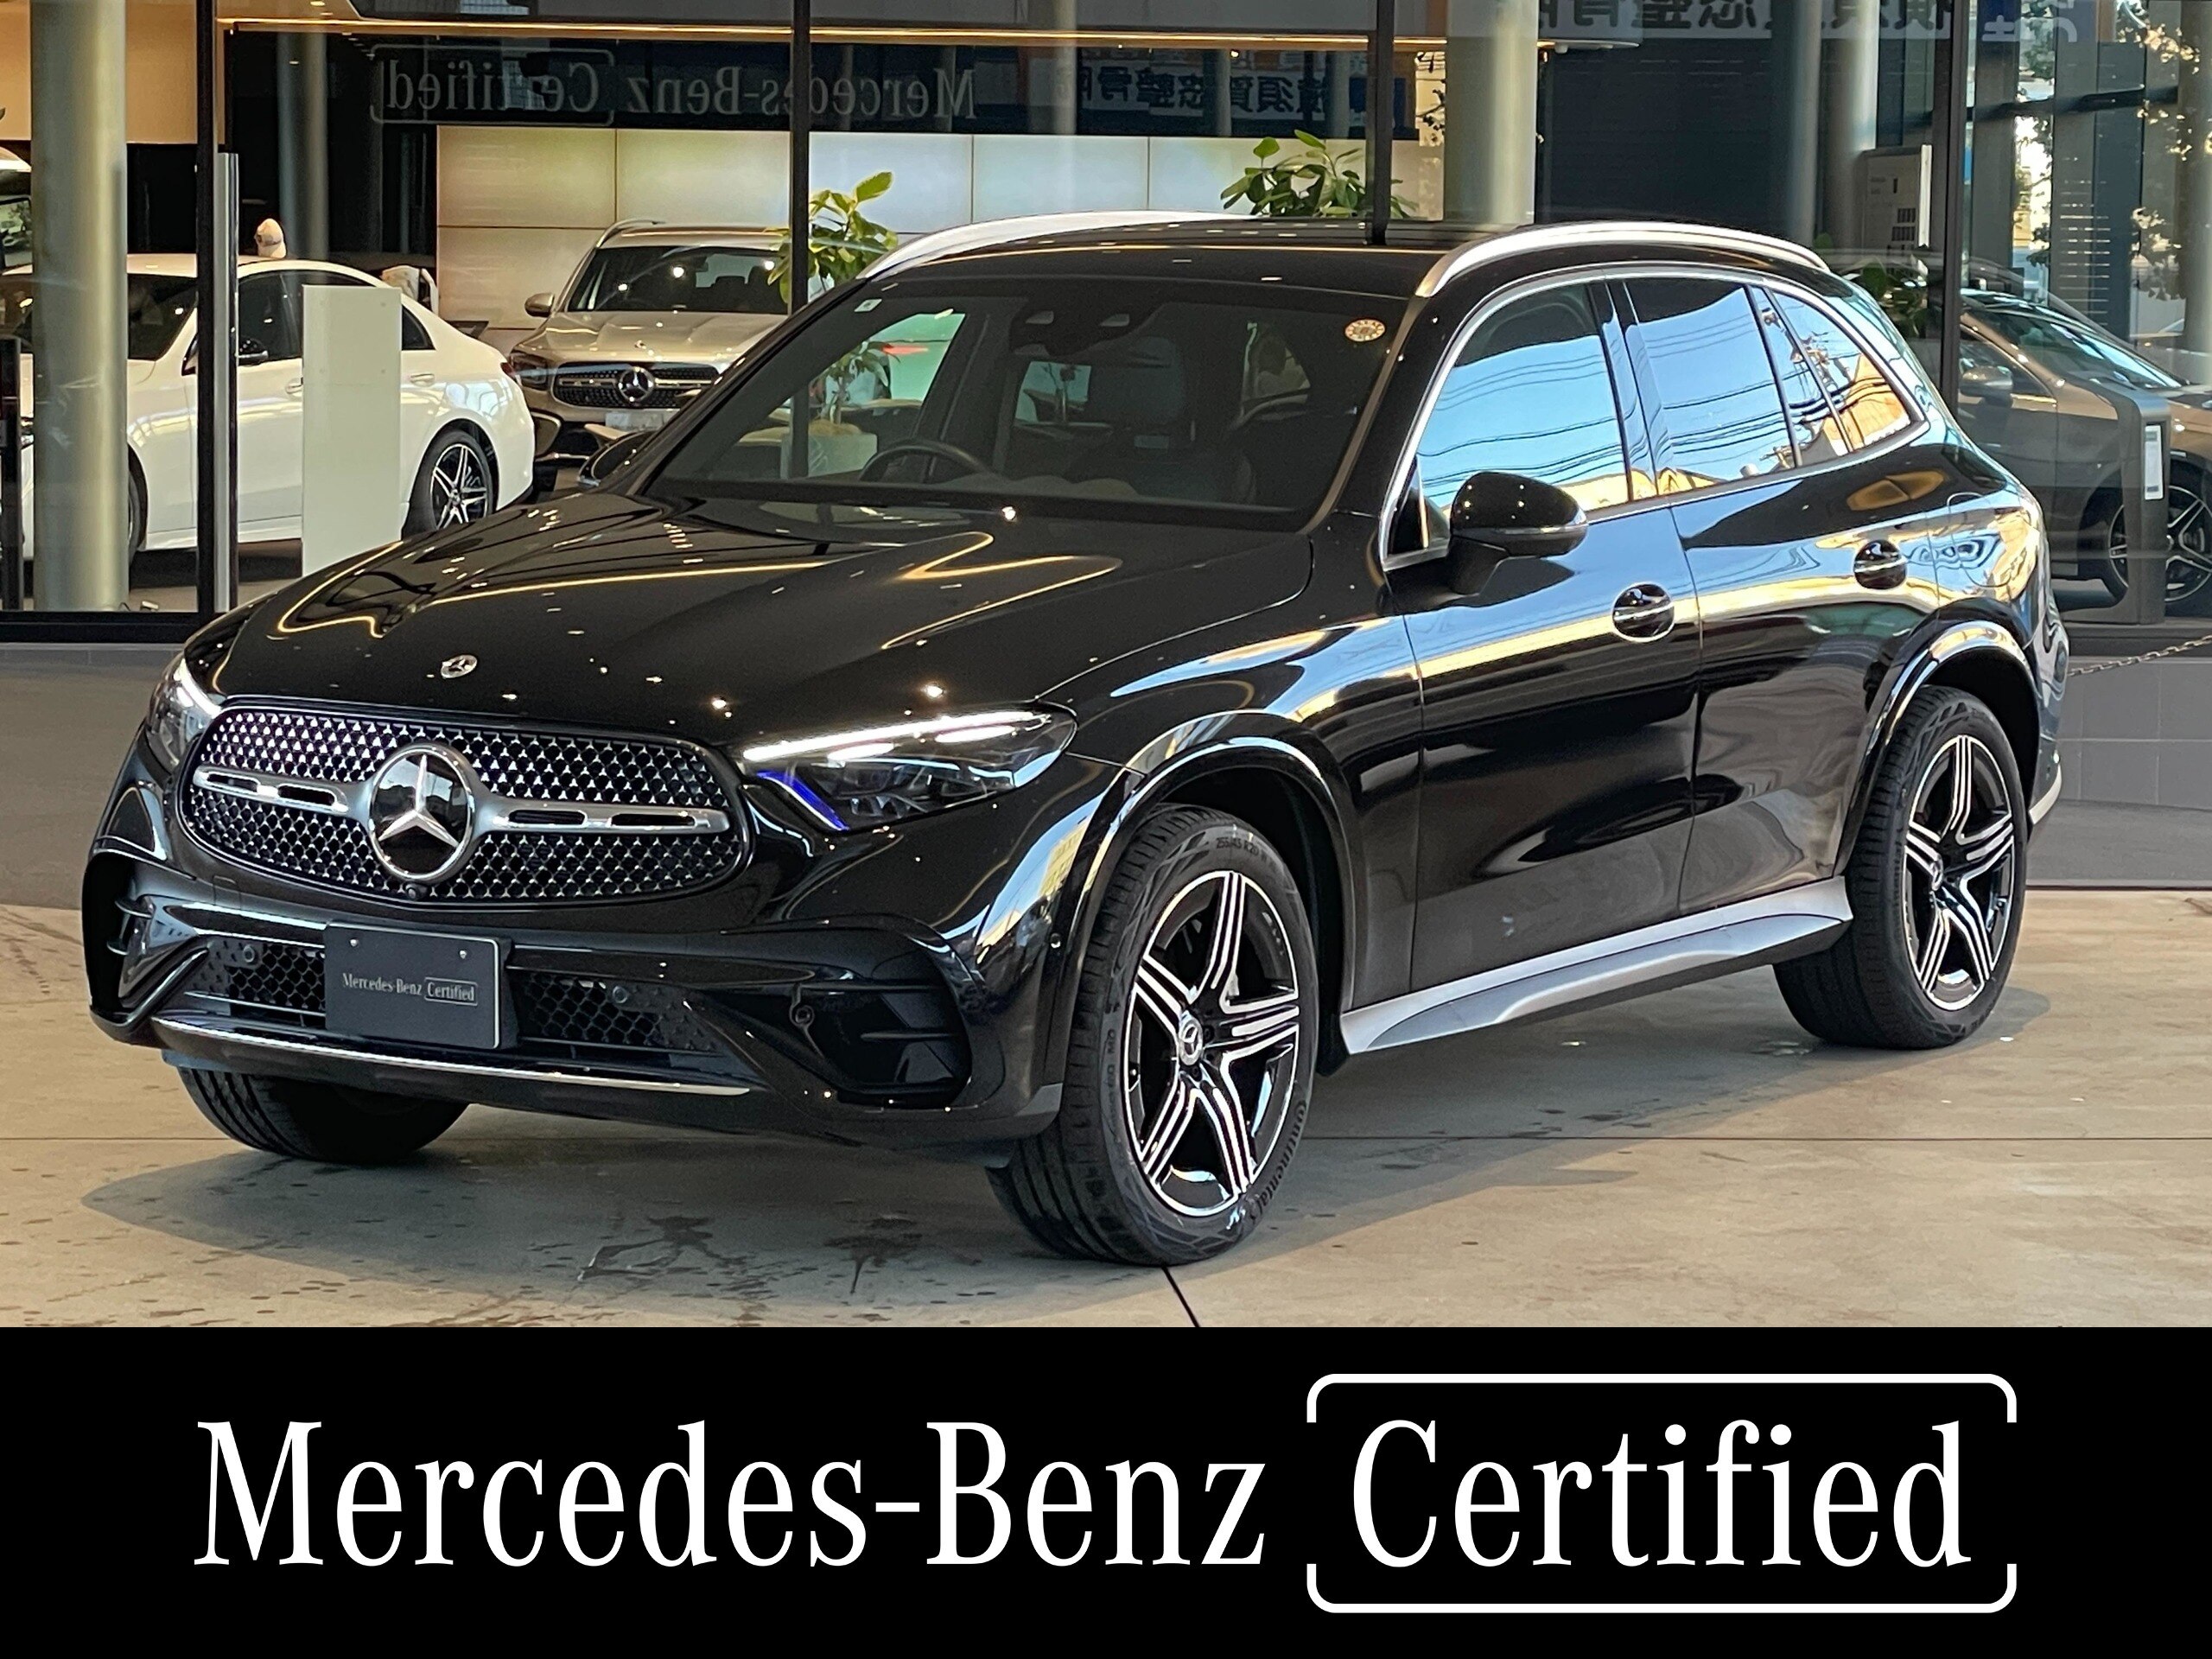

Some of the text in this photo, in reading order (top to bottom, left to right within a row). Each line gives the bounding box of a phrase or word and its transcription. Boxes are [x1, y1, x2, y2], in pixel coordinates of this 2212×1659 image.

[342, 973, 475, 1001] Mercedes-Benz Certified
[1256, 1100, 1306, 1215] Continental
